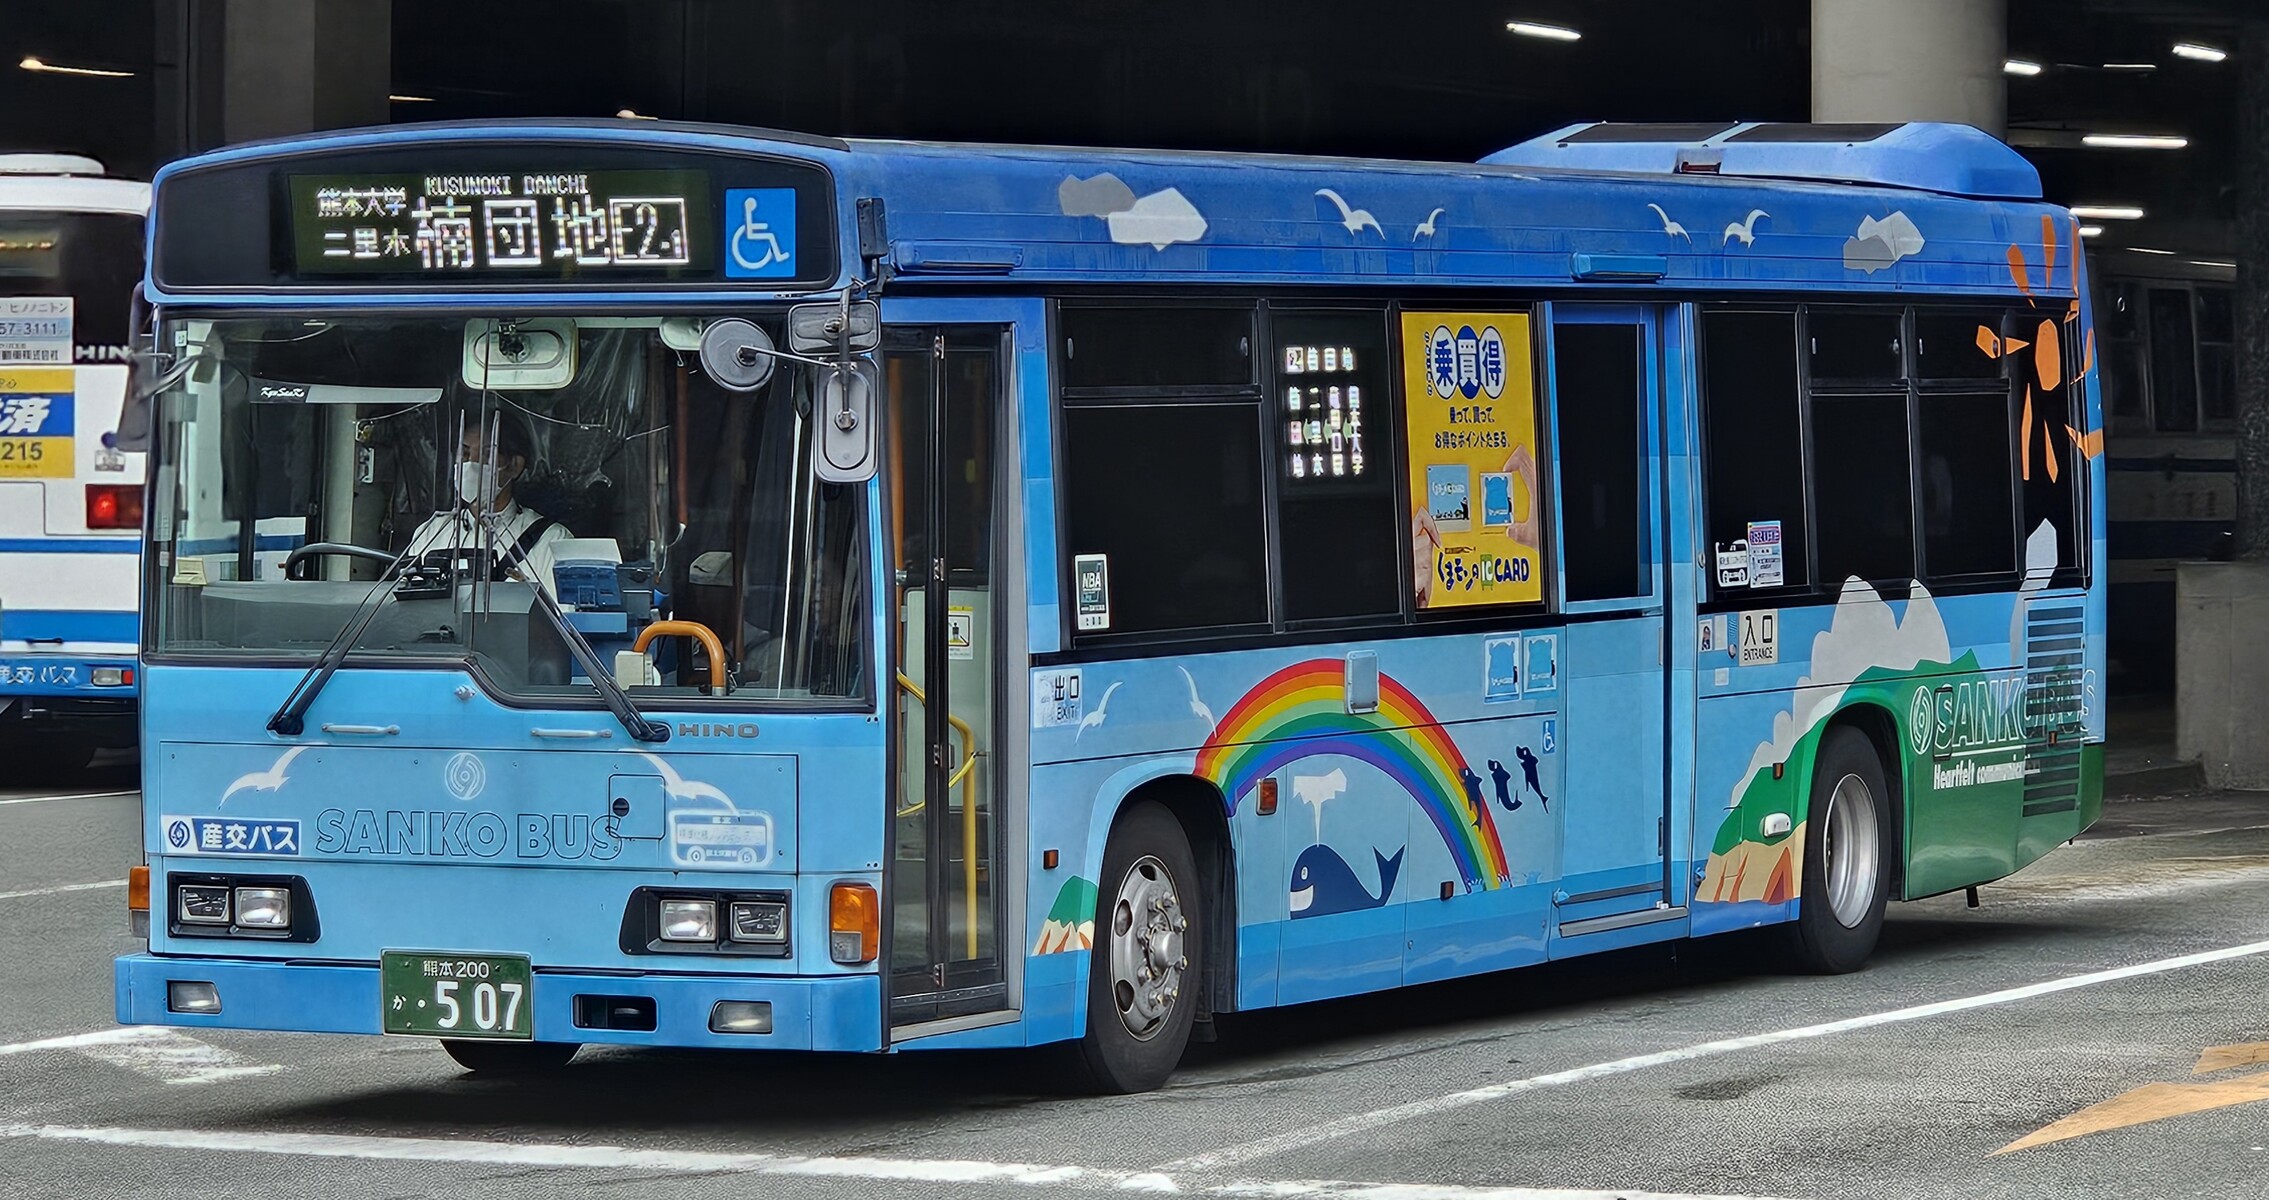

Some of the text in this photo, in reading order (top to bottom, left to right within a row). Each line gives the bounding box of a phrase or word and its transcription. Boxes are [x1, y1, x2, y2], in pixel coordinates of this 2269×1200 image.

[425, 174, 589, 196] KUSUNOKI DANCHI
[316, 187, 408, 217] 熊本大学
[323, 227, 412, 257] 二里木
[411, 194, 612, 268] 楠団地
[75, 345, 131, 360] HIN
[2, 442, 42, 461] 215
[1082, 572, 1102, 589] NBA
[1743, 614, 1774, 647] 入口
[1743, 646, 1773, 661] ENTRANCE
[1054, 674, 1080, 701] 出口
[679, 723, 760, 738] HINO
[1933, 759, 1975, 790] Heartfelt
[201, 822, 297, 851] 産交バス
[315, 808, 624, 861] SANKO BUS
[392, 995, 407, 1011] か
